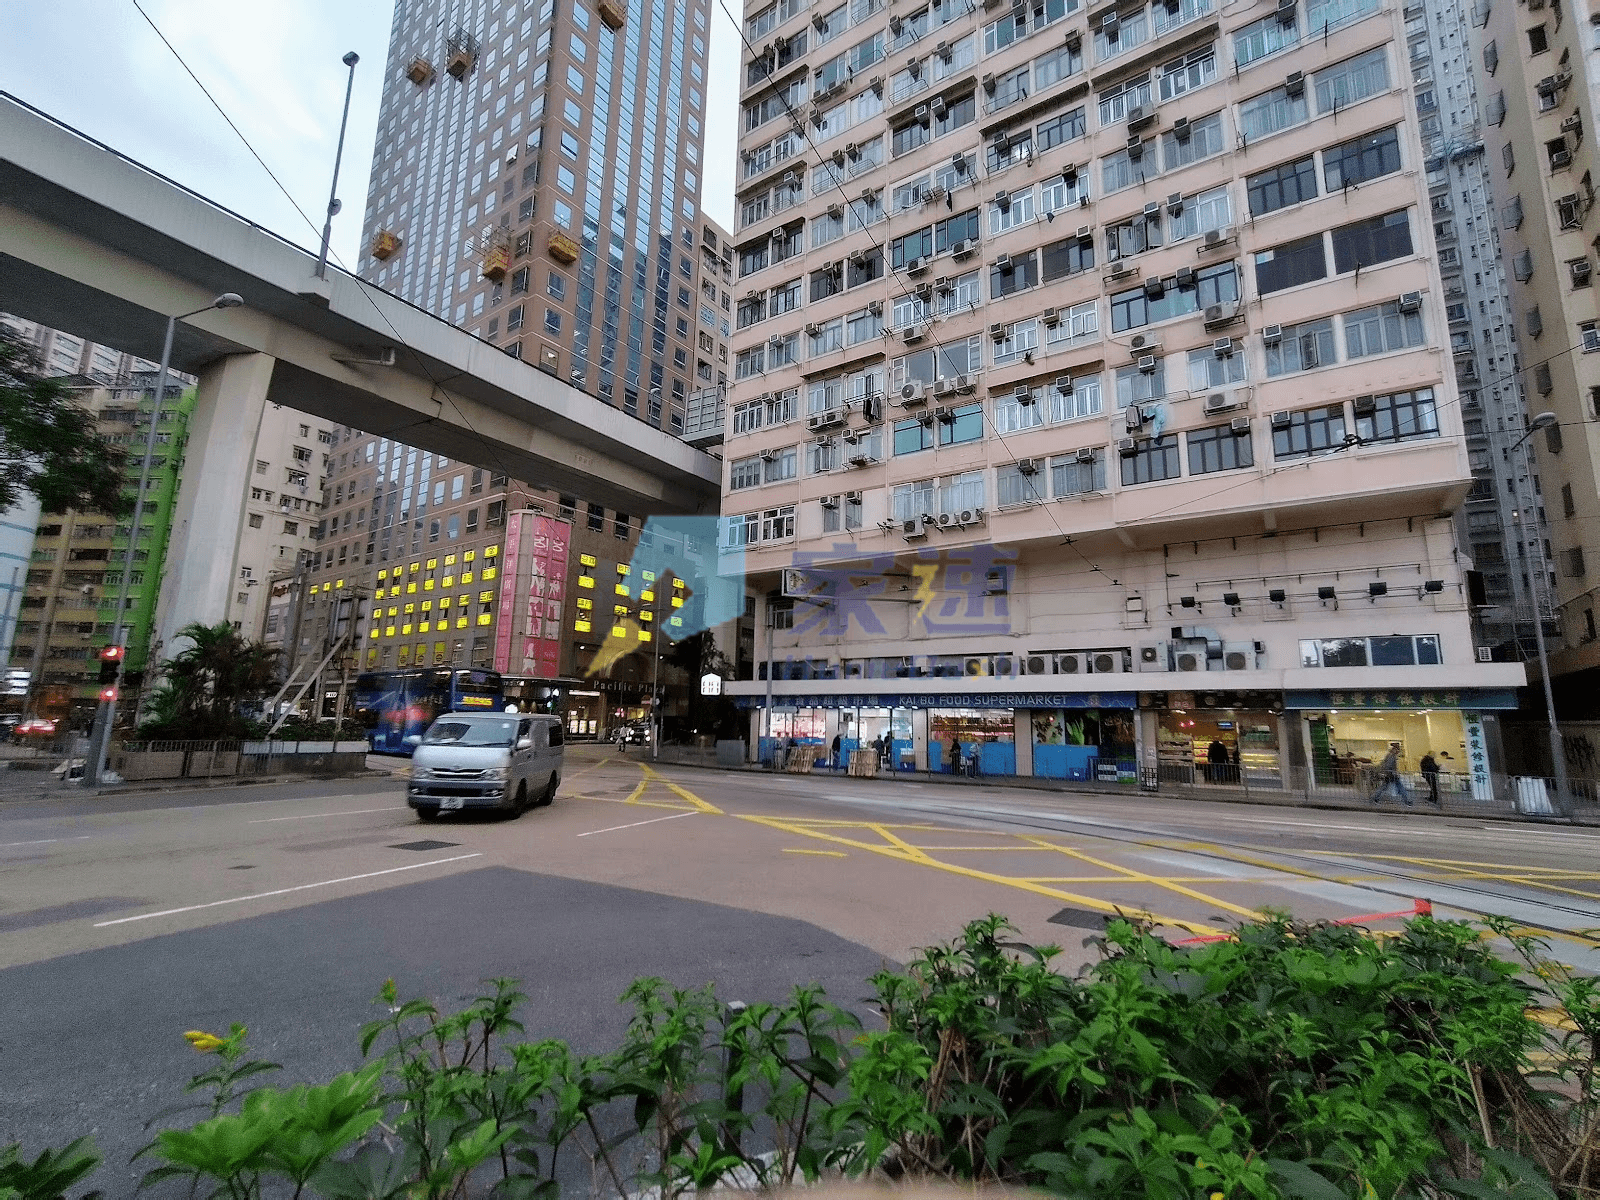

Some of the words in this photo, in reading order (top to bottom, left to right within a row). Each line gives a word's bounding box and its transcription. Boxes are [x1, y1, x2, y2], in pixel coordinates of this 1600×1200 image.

[593, 680, 633, 692] Pacific
[899, 695, 918, 705] KAI
[920, 695, 935, 705] BO
[939, 695, 970, 705] FOOD
[974, 694, 1069, 705] SUPERMARKET
